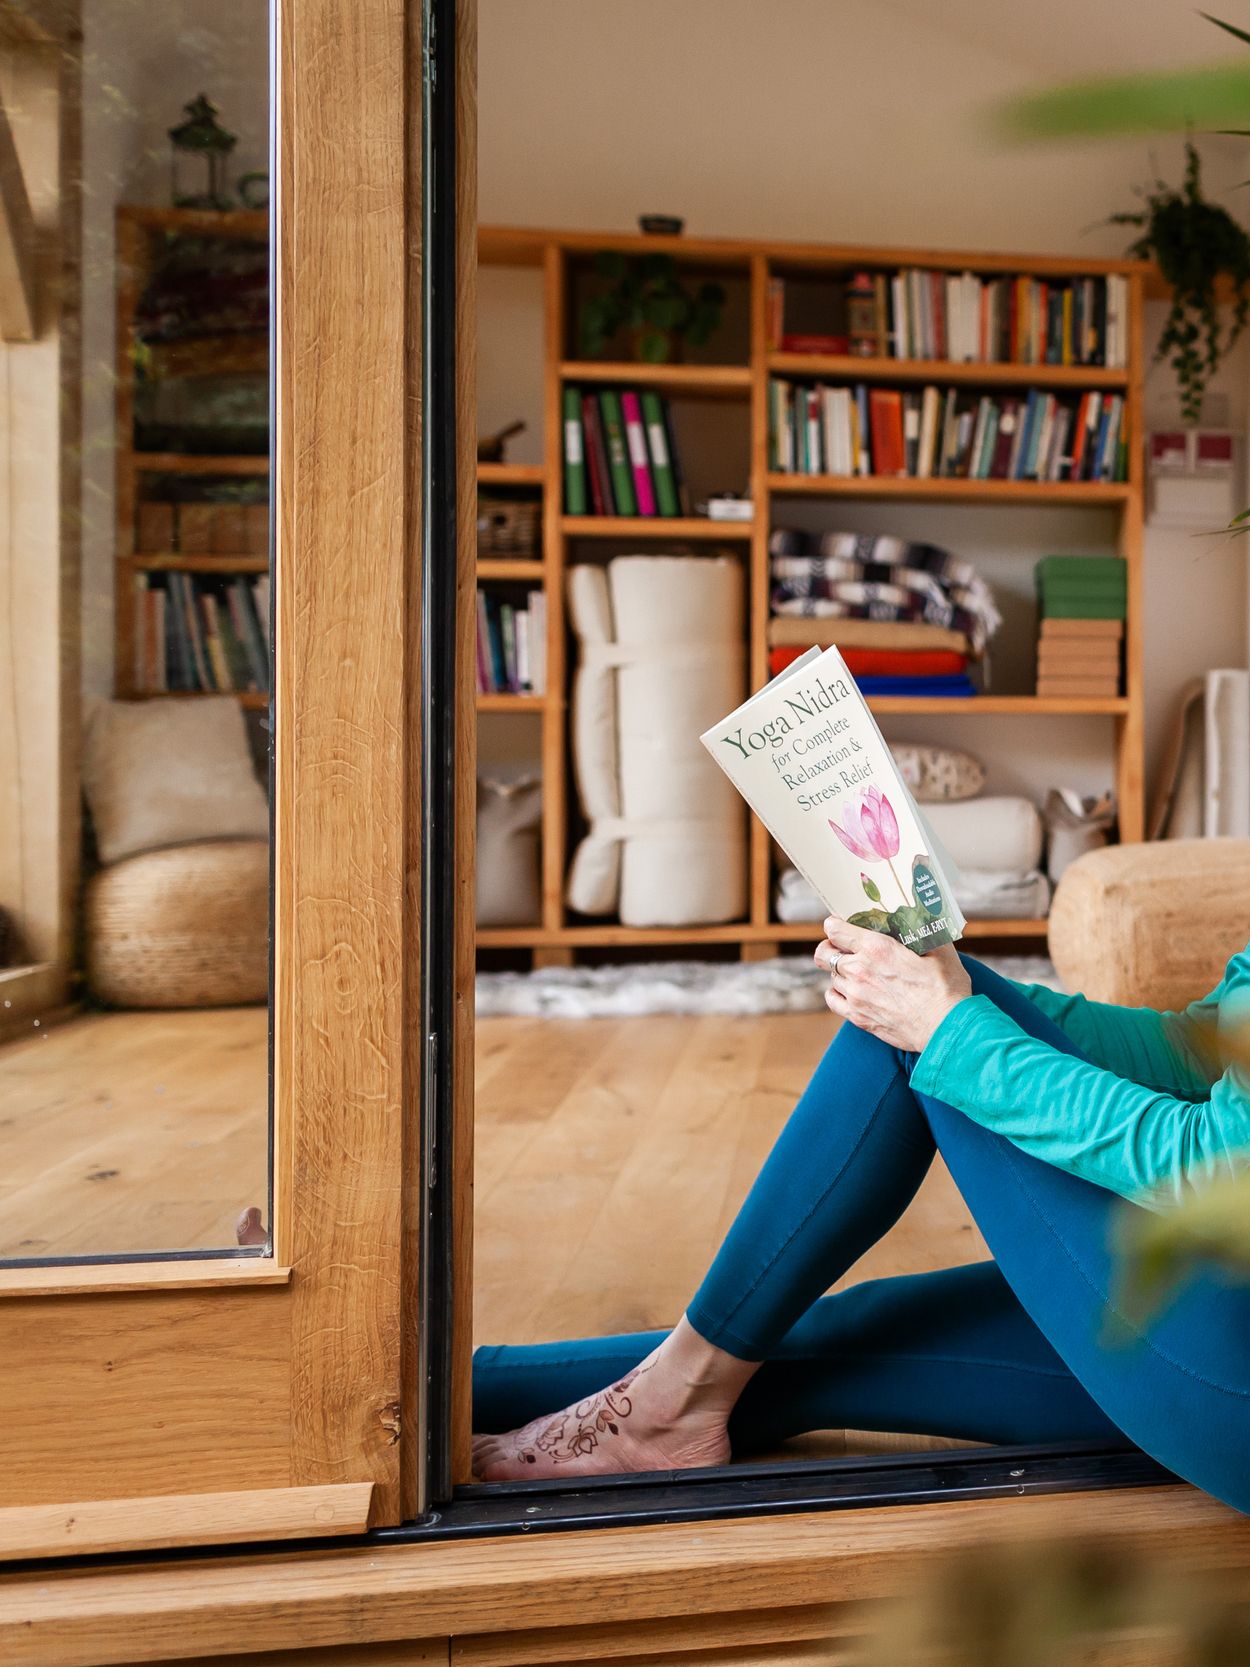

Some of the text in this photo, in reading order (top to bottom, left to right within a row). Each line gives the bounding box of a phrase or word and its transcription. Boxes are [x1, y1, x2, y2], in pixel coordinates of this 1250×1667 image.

[720, 678, 850, 760] Yoga Nidra
[771, 717, 850, 773] for Complete
[781, 737, 863, 790] Relaxation &
[797, 756, 874, 812] Stress Relief
